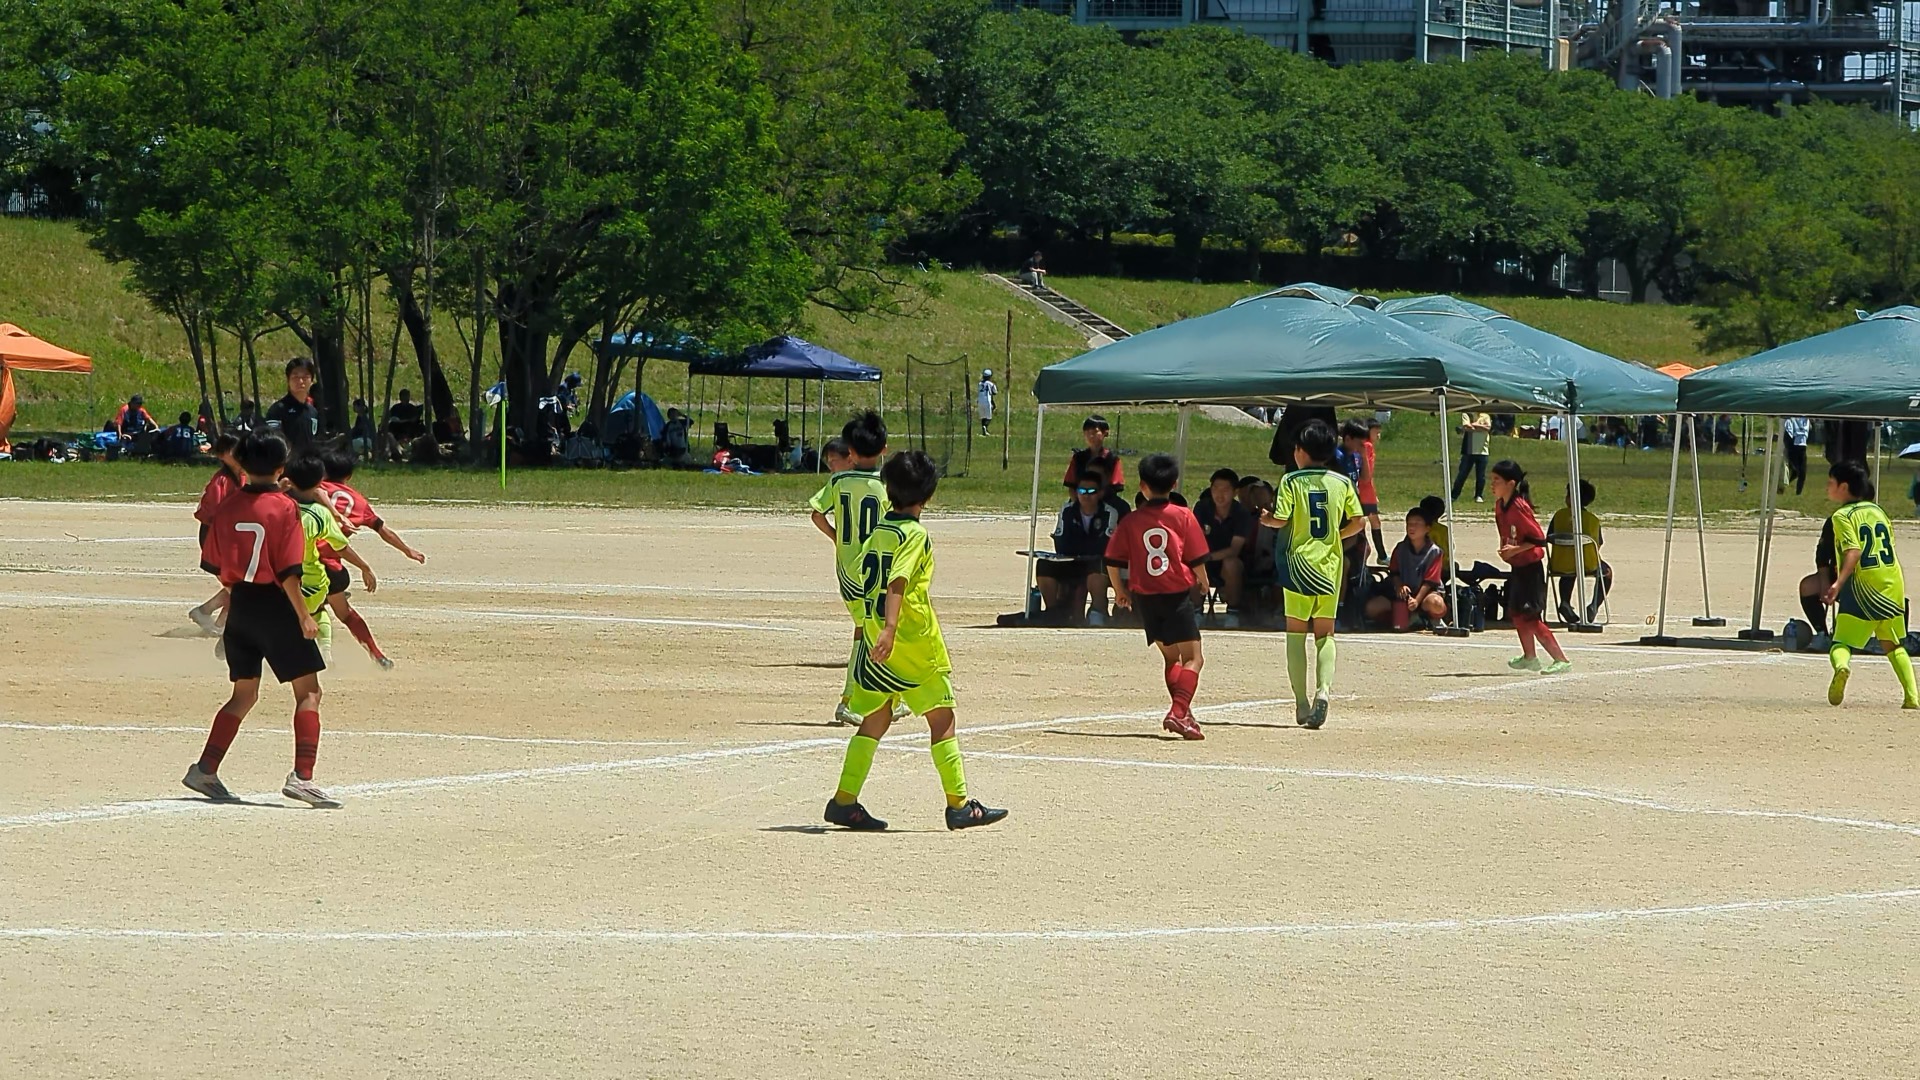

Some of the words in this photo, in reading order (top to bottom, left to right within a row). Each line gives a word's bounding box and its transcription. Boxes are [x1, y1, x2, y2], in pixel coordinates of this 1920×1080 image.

[840, 492, 880, 545] 10
[1308, 490, 1330, 541] 5
[234, 522, 266, 583] 7
[1143, 528, 1170, 577] 8
[1859, 521, 1896, 570] 23
